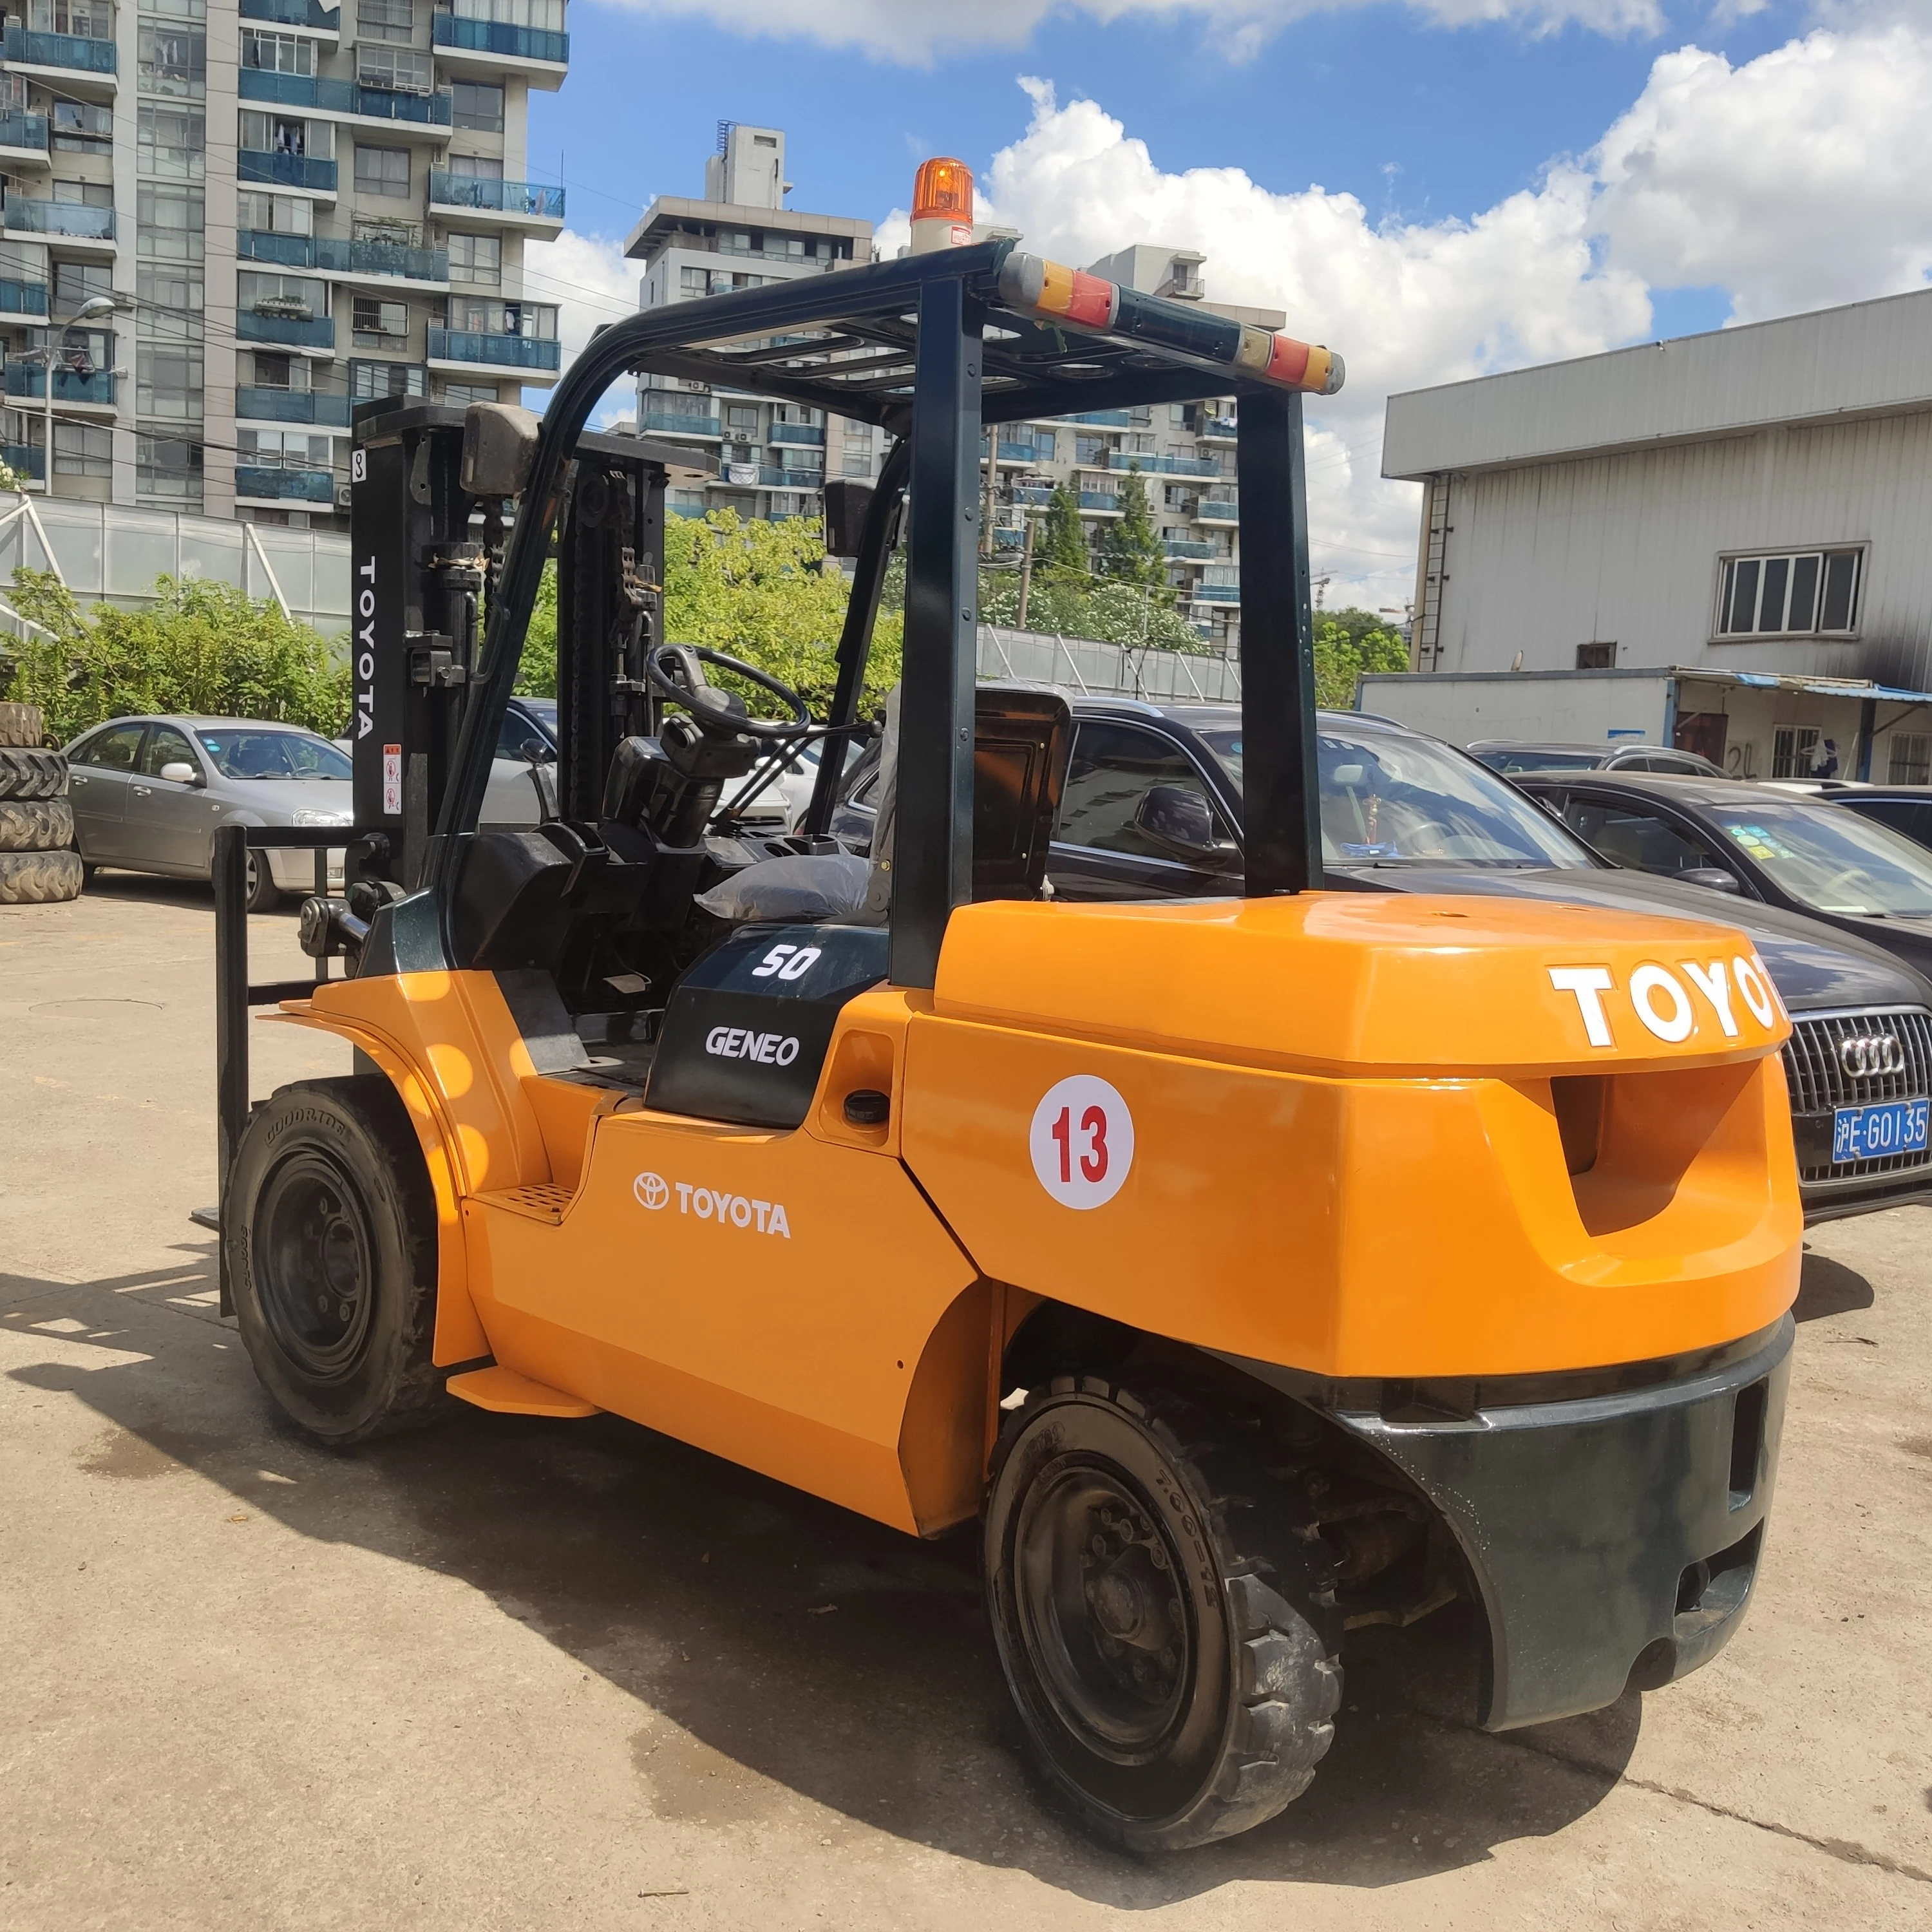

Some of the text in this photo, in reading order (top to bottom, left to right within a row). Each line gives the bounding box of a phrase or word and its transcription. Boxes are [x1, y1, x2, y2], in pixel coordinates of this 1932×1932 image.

[358, 556, 375, 740] TOYOTA
[752, 944, 822, 980] 50
[705, 1027, 799, 1066] GENEO
[1052, 1105, 1108, 1183] 13
[675, 1182, 791, 1238] TOYOTA
